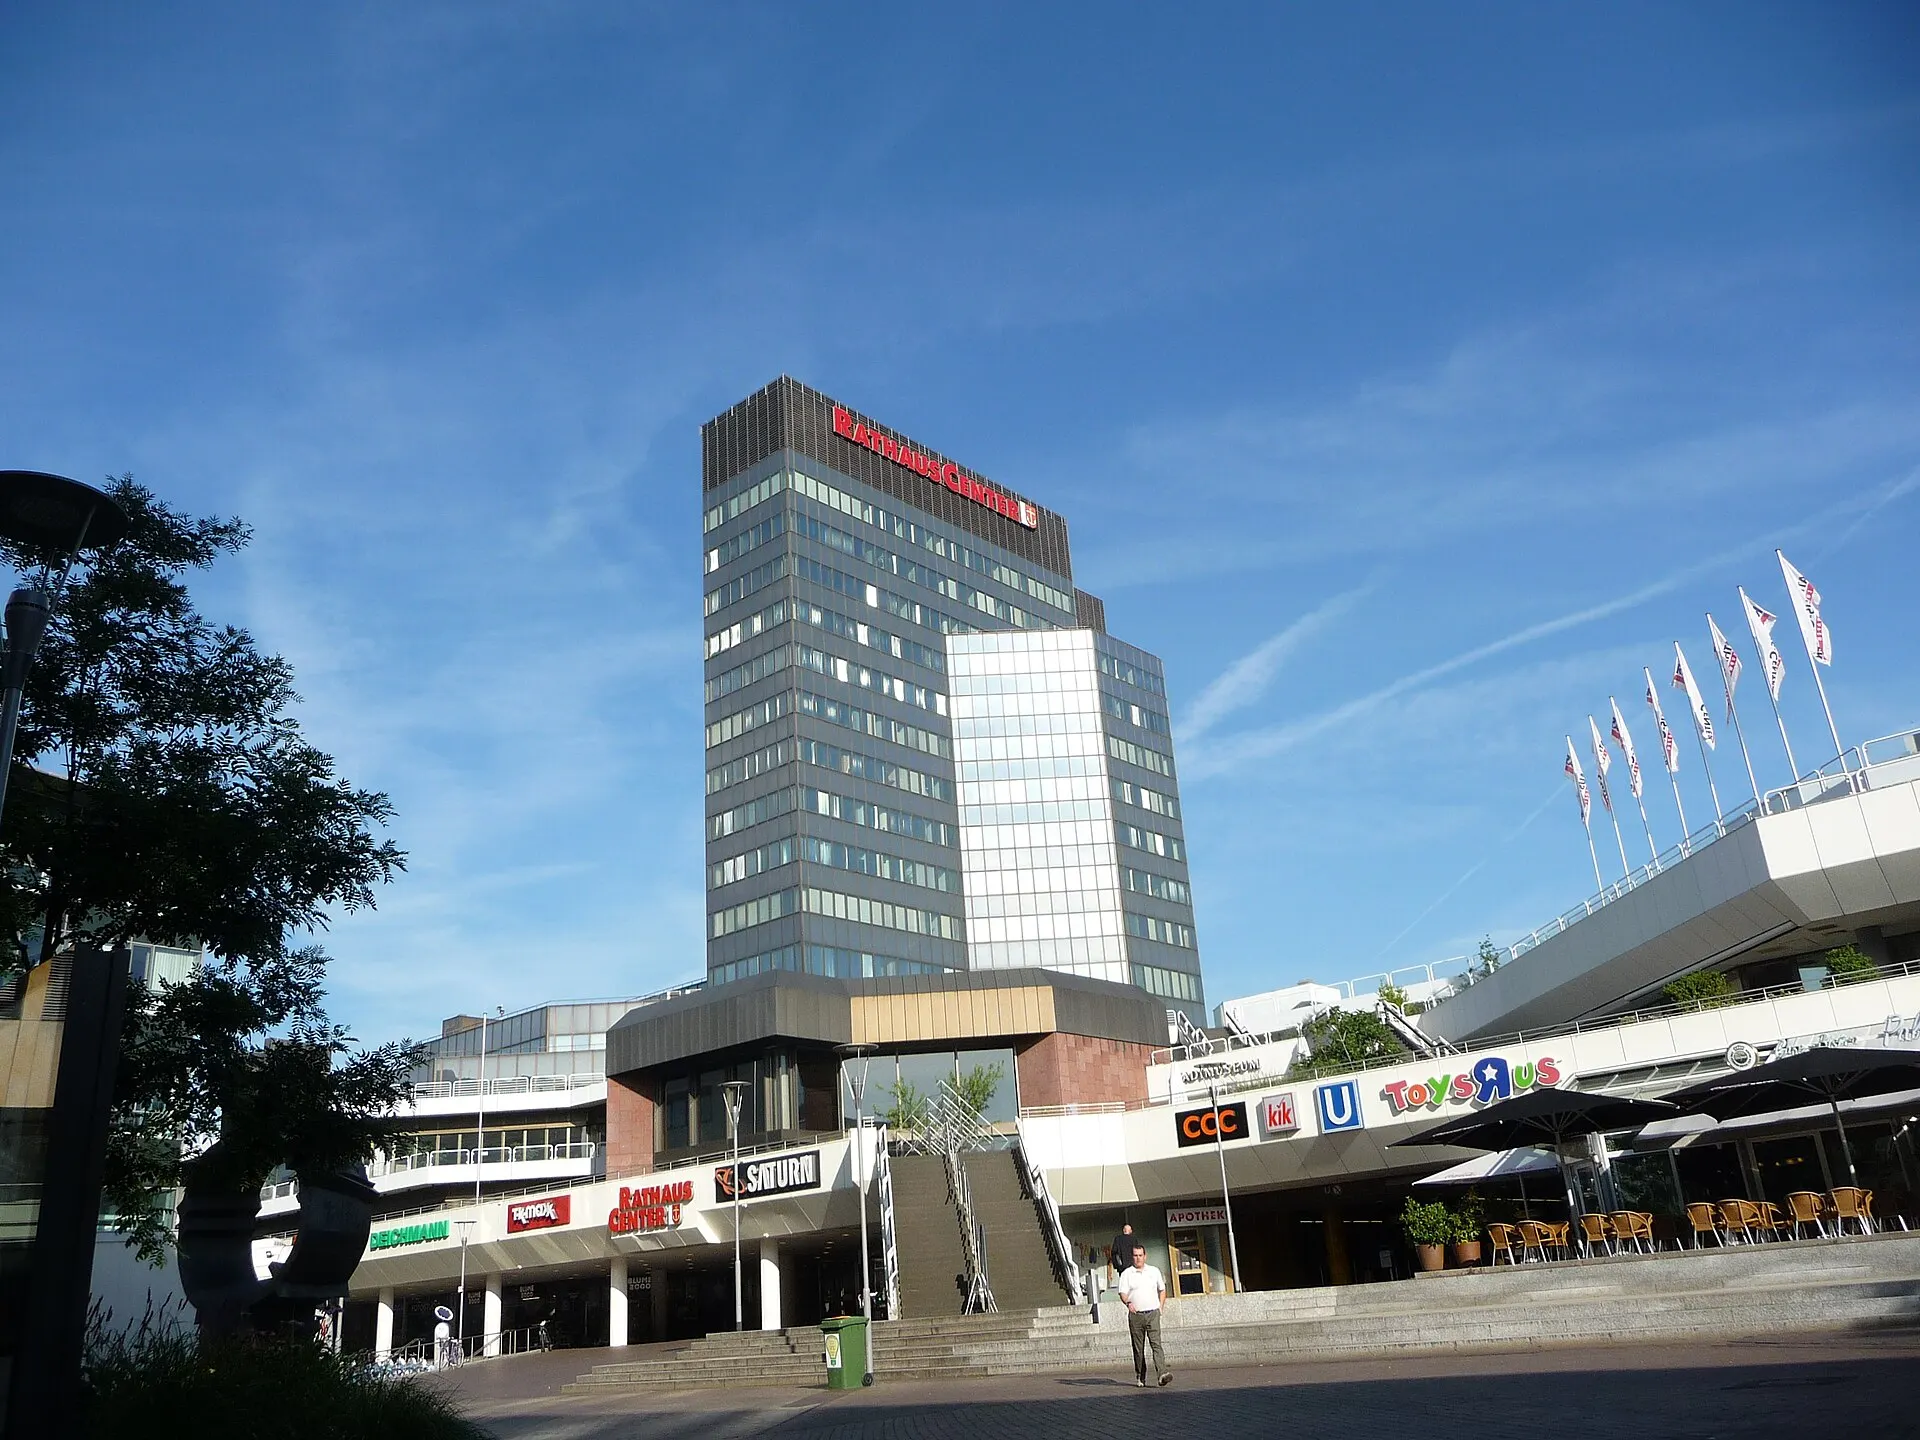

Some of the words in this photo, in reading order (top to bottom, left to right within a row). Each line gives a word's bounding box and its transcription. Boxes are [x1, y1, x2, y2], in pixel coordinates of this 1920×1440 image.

[1323, 1085, 1352, 1125] U
[1182, 1109, 1238, 1139] CCC
[747, 1154, 815, 1193] SATURN
[619, 1180, 694, 1210] RATHAUS
[608, 1205, 668, 1233] CENTER
[1169, 1210, 1227, 1222] APOTHEK
[370, 1220, 450, 1251] DEICHMANN
